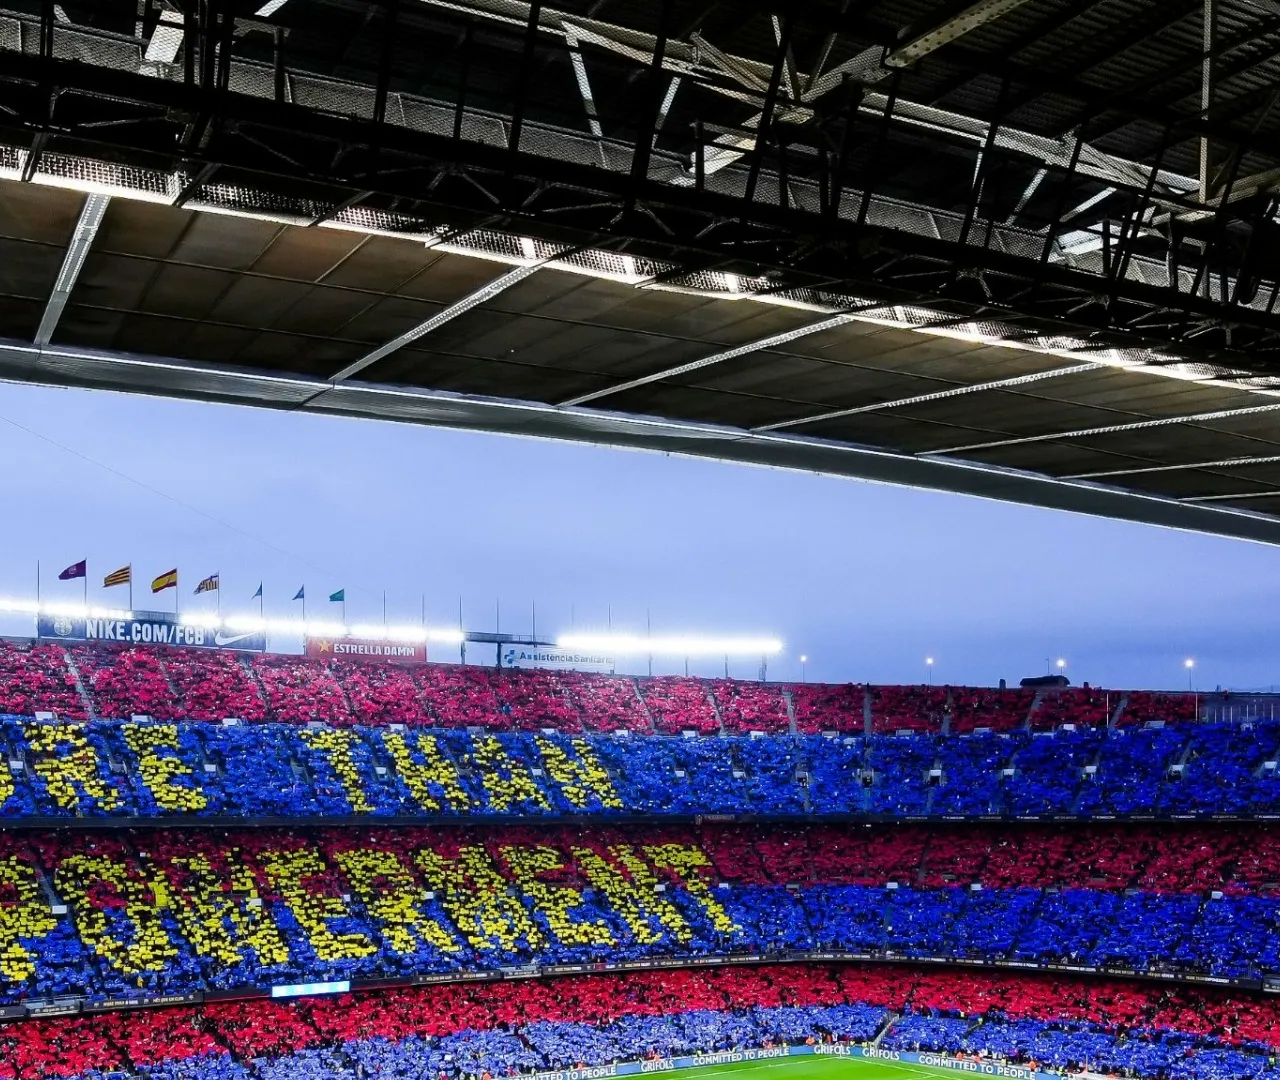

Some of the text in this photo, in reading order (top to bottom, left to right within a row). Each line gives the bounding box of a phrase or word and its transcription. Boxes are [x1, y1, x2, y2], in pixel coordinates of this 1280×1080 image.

[86, 620, 205, 645] NIKE.COM/FCB
[333, 643, 415, 657] ESTRELLA DAMM
[693, 1047, 789, 1066] COMMITTED TO PEOPLE
[814, 1045, 851, 1056] GRIFOLS
[862, 1048, 900, 1060] GRIFOLS
[641, 1060, 674, 1072] GRIFOLS
[919, 1055, 1035, 1080] COMMITTED TO PEOPLE
[566, 1072, 578, 1080] TO
[582, 1067, 616, 1079] PEOPLE
